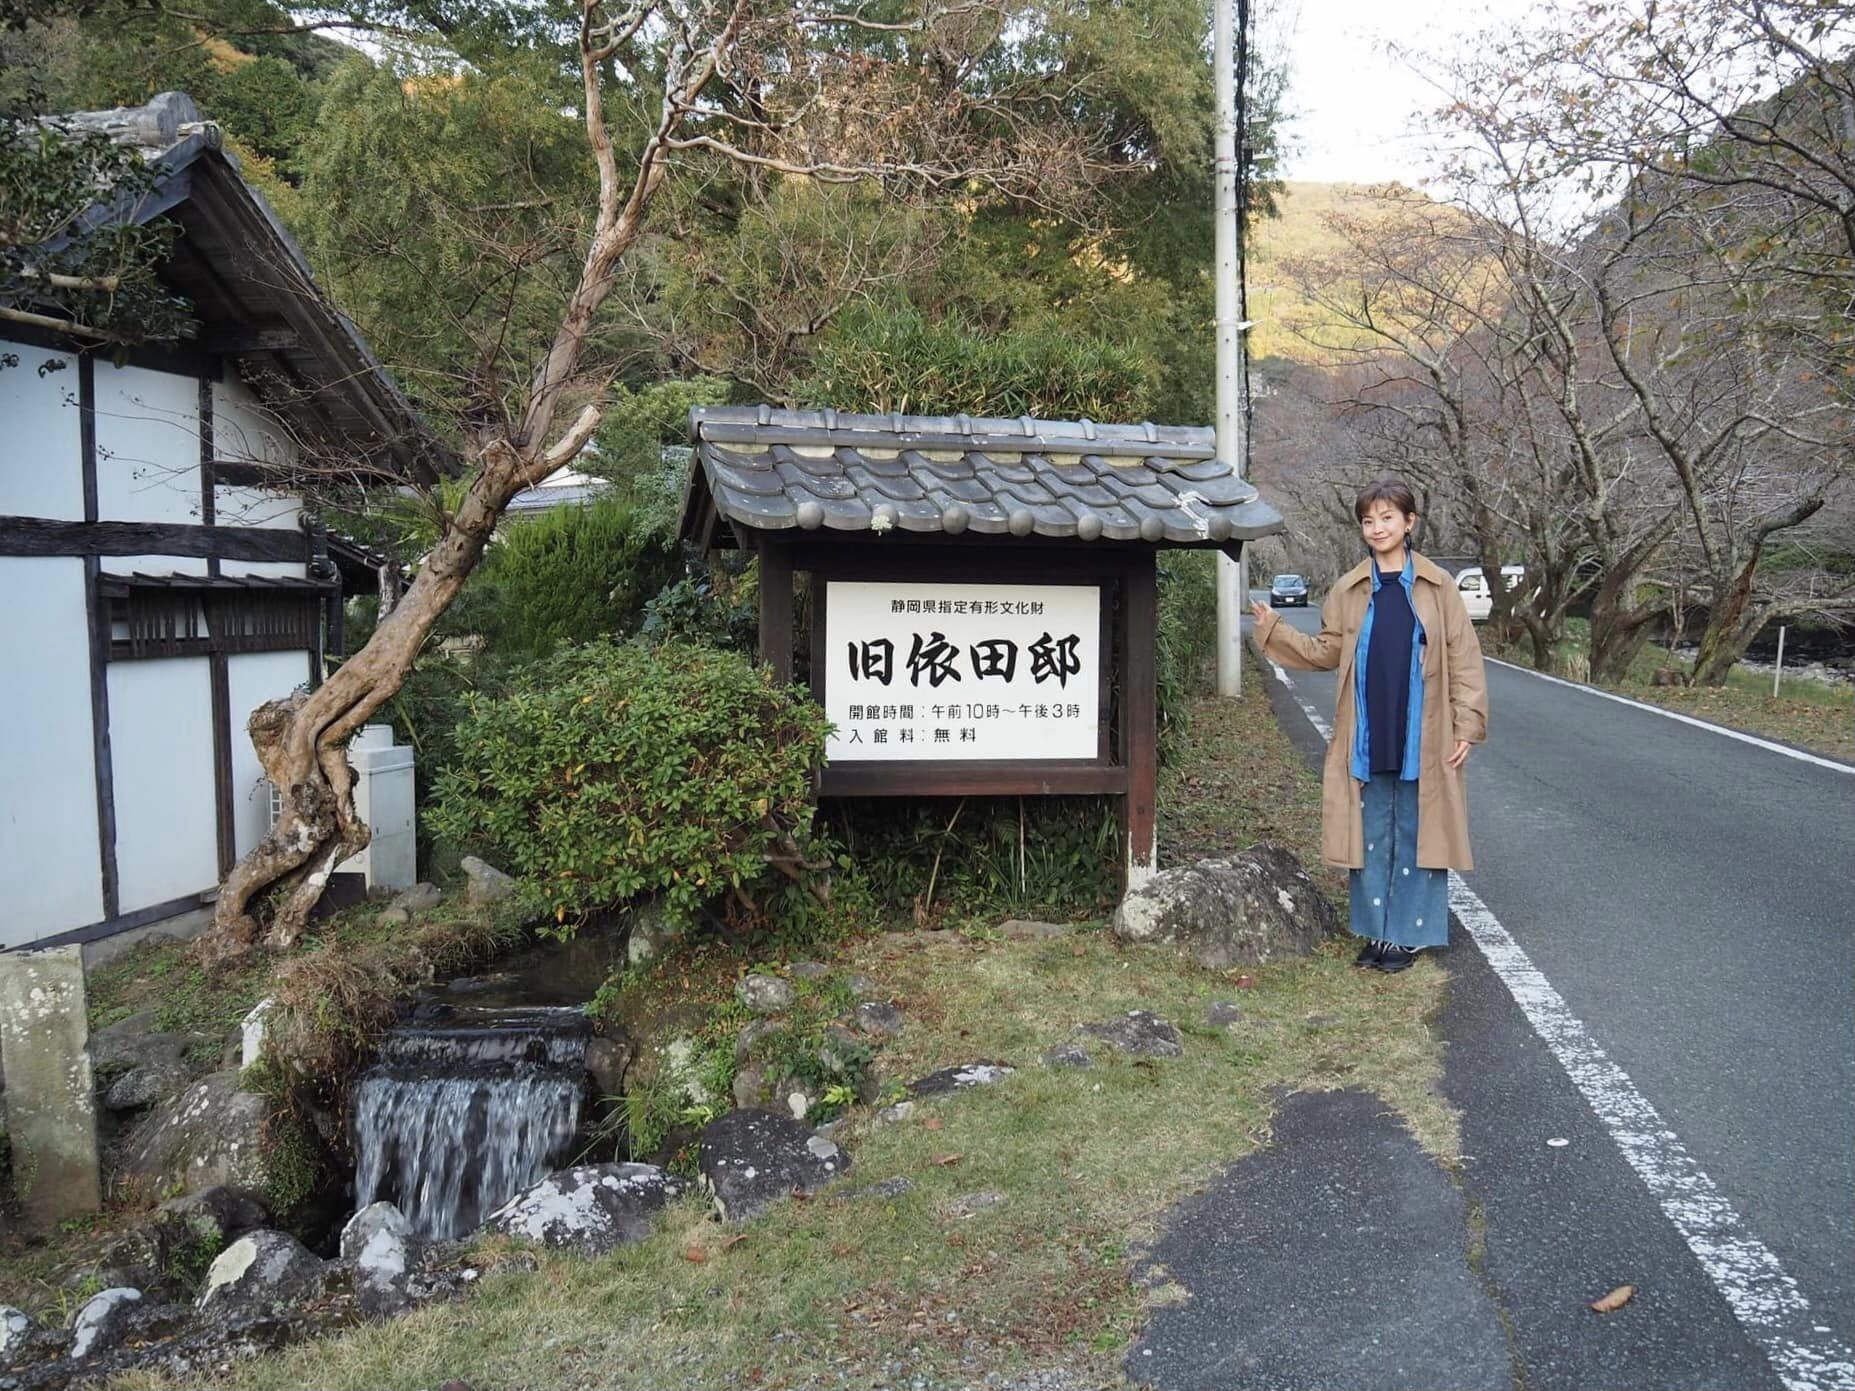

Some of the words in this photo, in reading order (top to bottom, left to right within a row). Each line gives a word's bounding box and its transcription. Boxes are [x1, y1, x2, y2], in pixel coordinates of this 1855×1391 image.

[891, 599, 1044, 615] 静岡県指定有形文化財
[847, 631, 1081, 690] 旧依田邸
